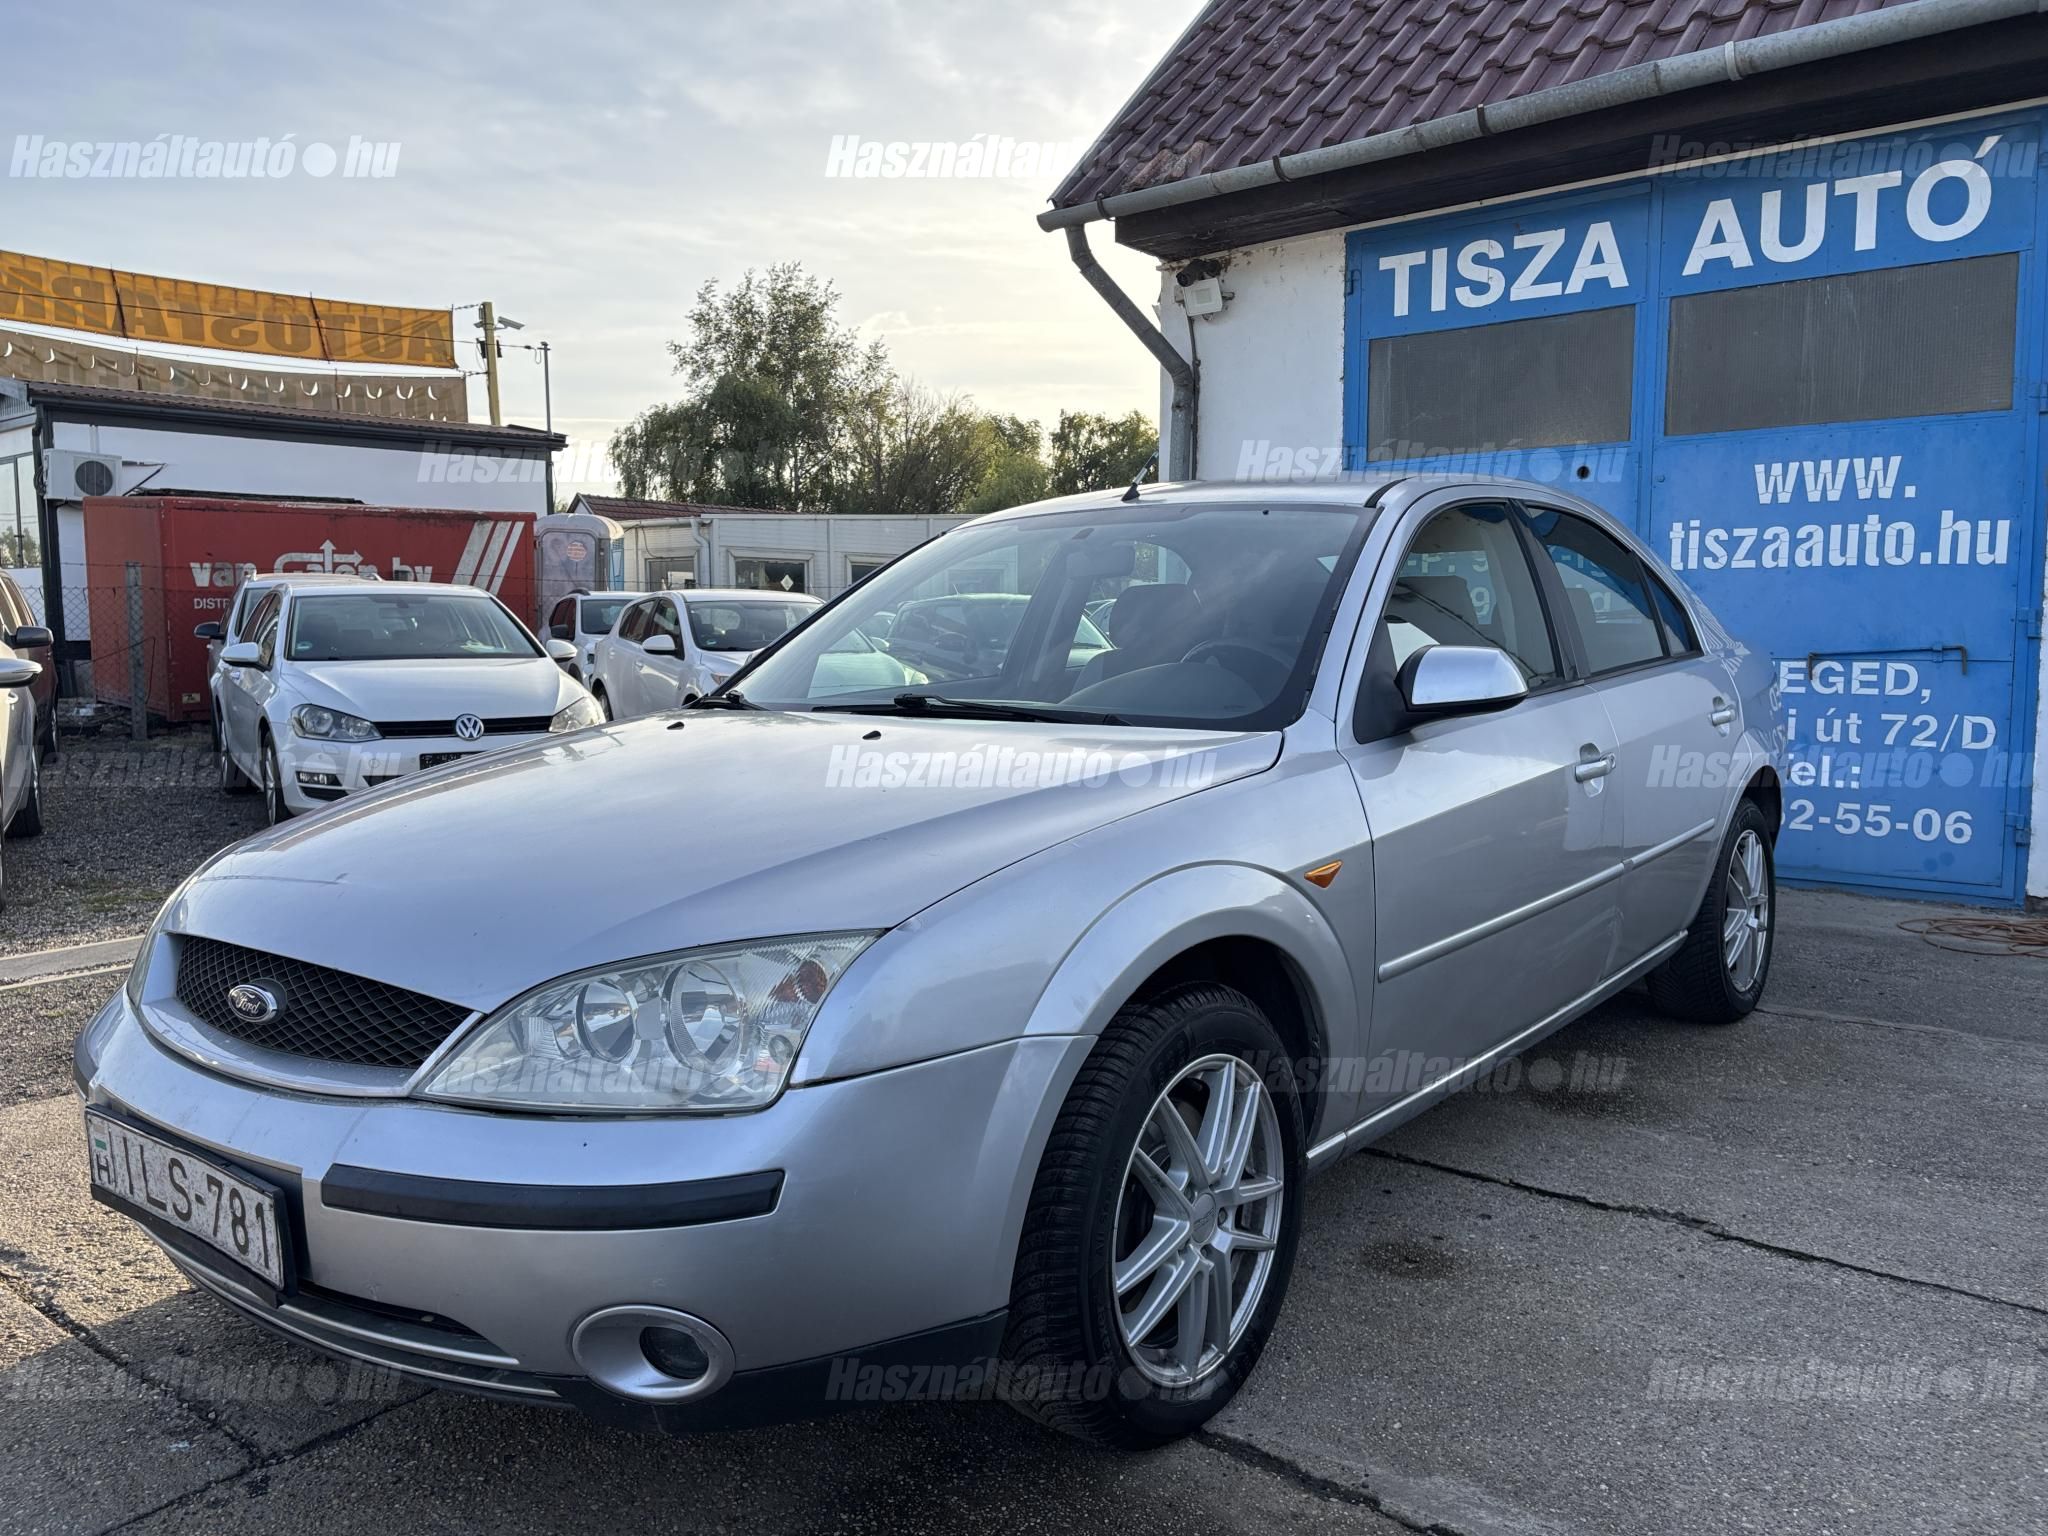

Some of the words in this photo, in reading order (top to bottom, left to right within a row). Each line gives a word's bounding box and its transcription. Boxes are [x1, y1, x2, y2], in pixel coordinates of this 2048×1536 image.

[1378, 221, 1630, 317] TISZA
[1682, 134, 2003, 277] AUTÓ
[1754, 455, 1917, 505] www.
[1669, 509, 2011, 571] tiszaauto.hu
[1778, 661, 1931, 704] EGED,
[1816, 707, 1862, 744] út
[1881, 713, 1997, 752] 72/D
[1788, 753, 1861, 789] el.:
[1781, 799, 1973, 844] 2-55-06
[235, 991, 261, 1014] Ford
[97, 1154, 111, 1185] H
[123, 1136, 270, 1270] ILS-781
